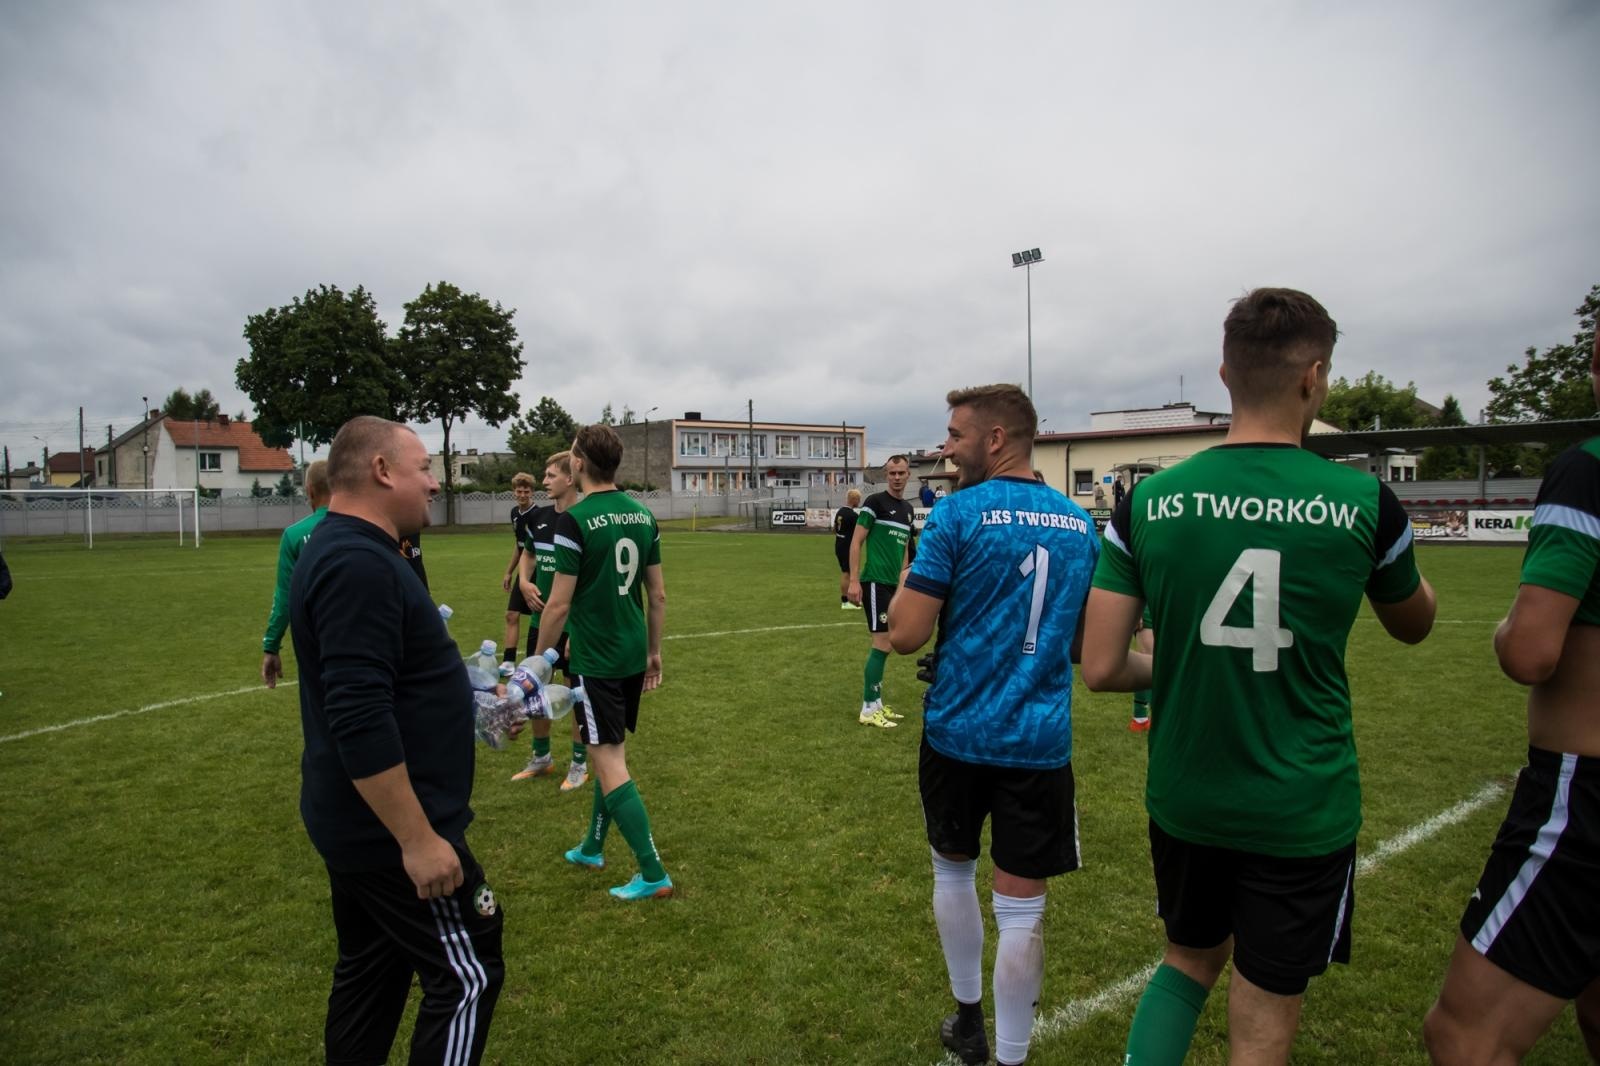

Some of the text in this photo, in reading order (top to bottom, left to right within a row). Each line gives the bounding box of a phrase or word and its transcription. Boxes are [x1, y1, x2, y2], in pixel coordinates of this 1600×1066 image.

[587, 511, 651, 530] LKS TWORKÓW
[982, 510, 1087, 534] LKS TWORKÓW
[1147, 493, 1358, 529] LKS TWORKÓW
[615, 537, 639, 595] 9
[1018, 543, 1049, 654] 1
[1200, 548, 1294, 672] 4
